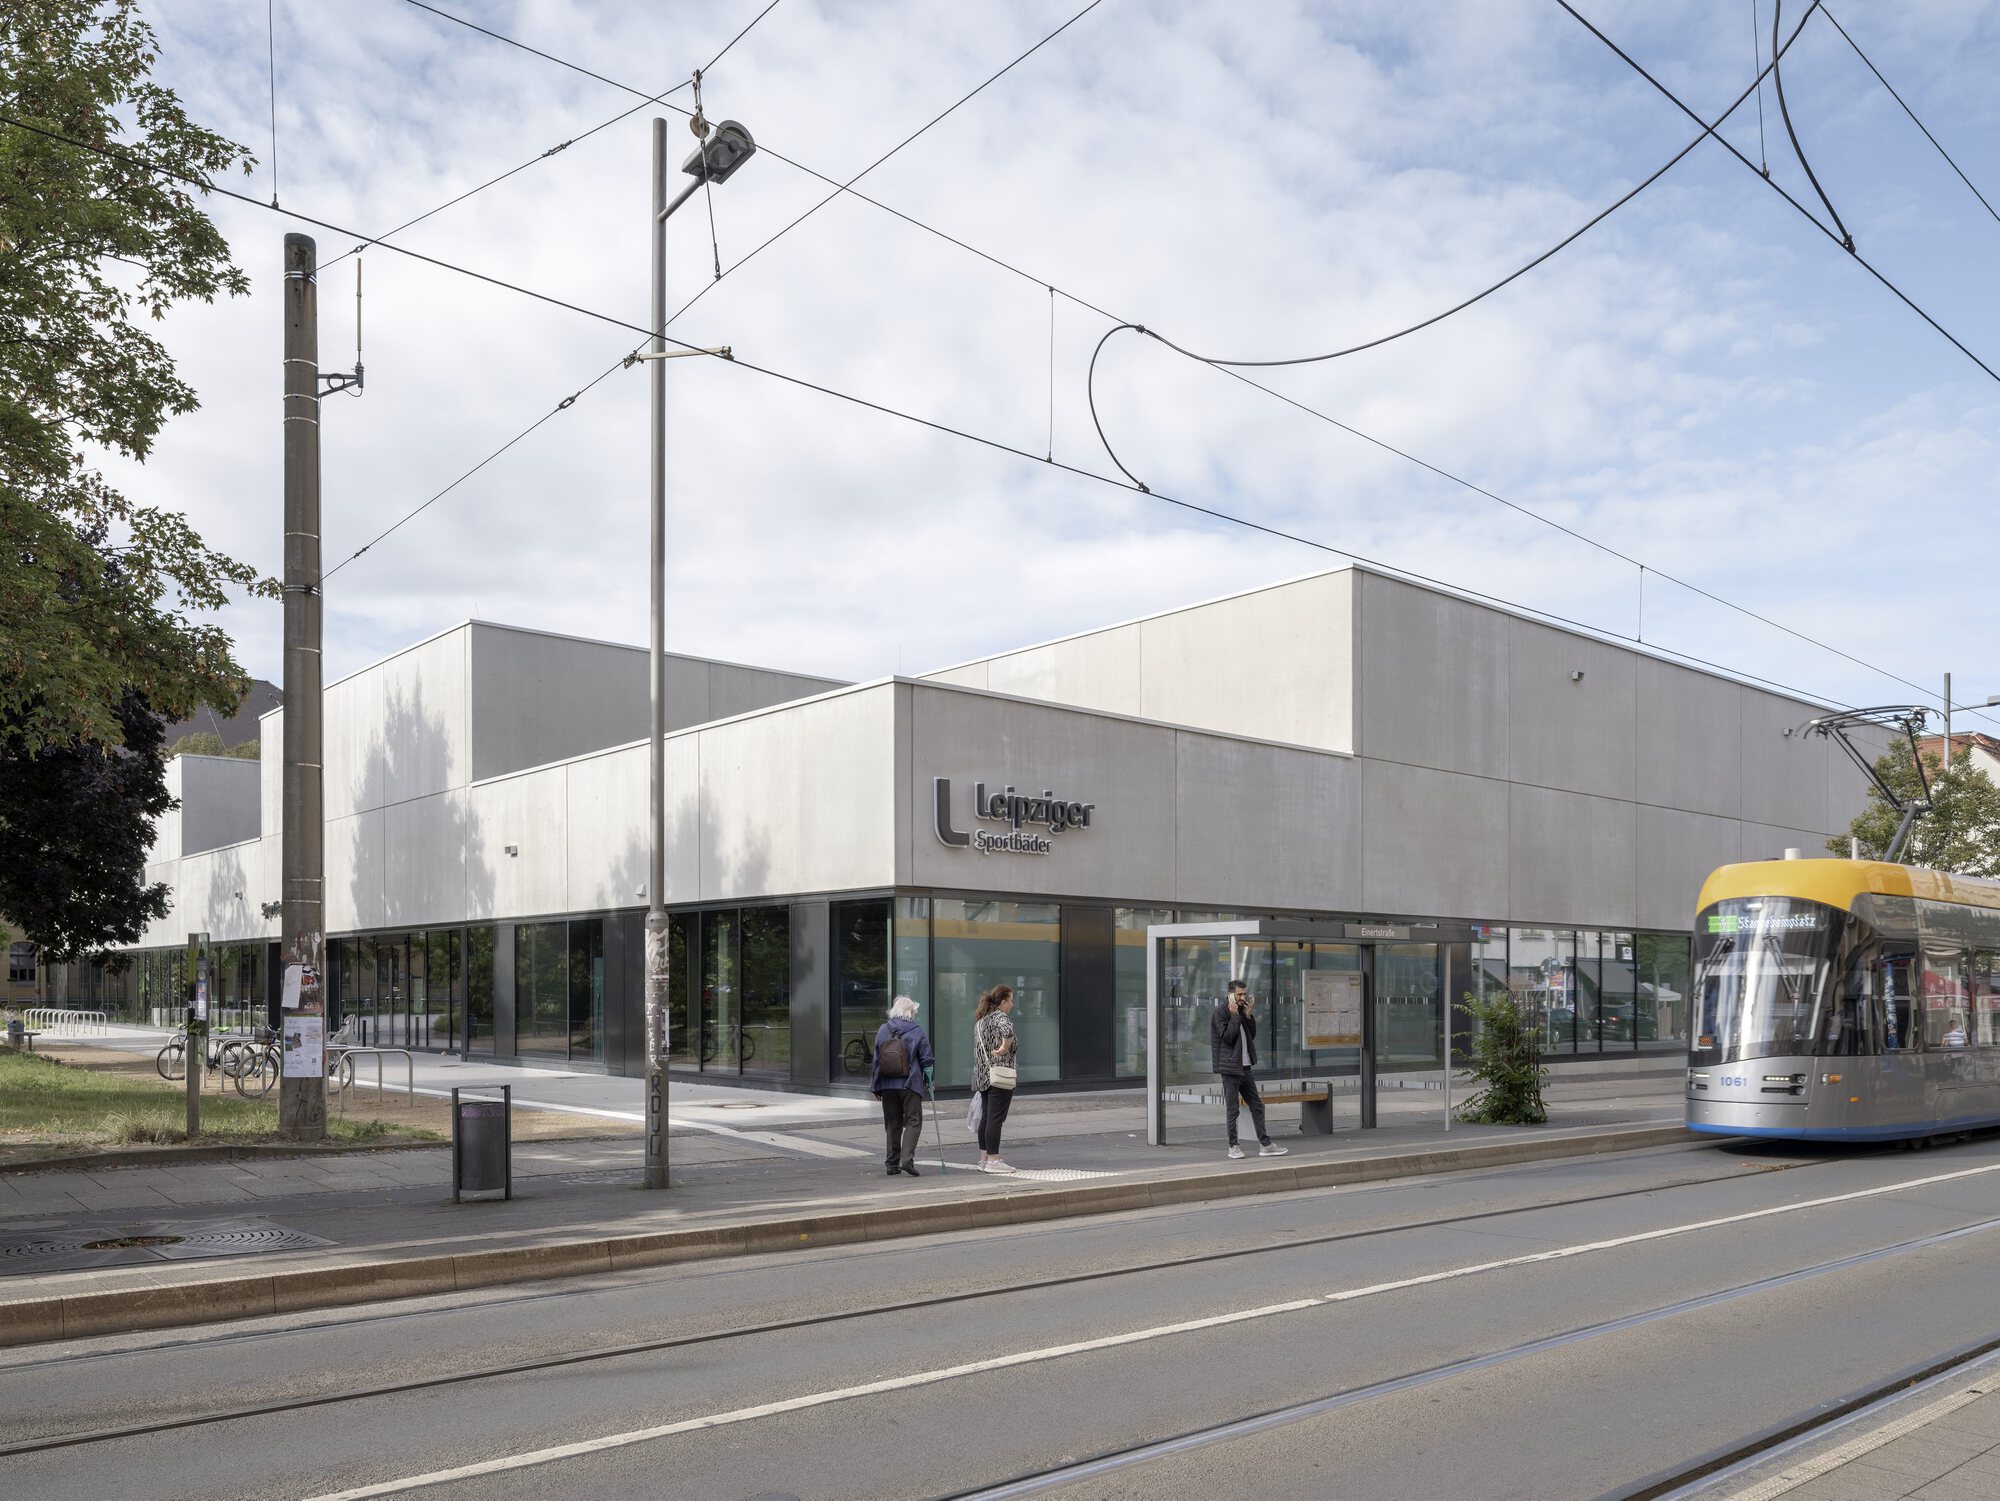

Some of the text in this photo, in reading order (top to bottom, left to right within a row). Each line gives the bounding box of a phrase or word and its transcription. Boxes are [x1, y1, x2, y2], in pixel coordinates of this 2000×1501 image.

[975, 782, 1095, 834] Leipziger
[975, 829, 1052, 855] Sportbäder
[1361, 927, 1396, 937] Einertstraße
[1720, 1076, 1747, 1087] 1061
